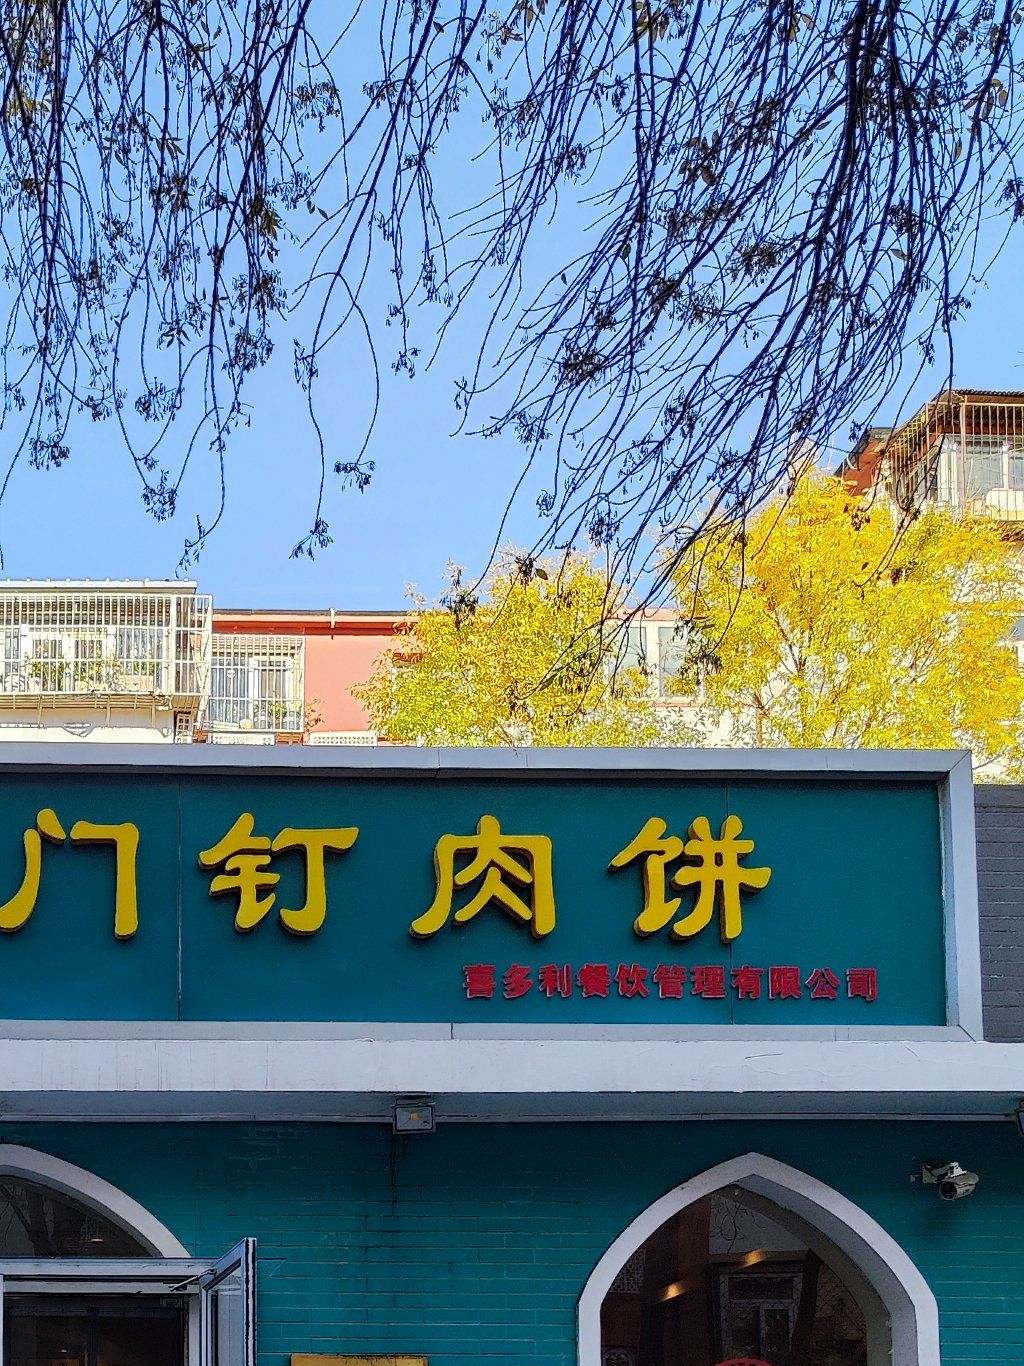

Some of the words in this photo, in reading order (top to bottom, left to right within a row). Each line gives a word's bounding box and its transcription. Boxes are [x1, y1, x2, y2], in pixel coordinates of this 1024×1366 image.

[462, 963, 878, 1001] 喜多利餐饮管理有限公司
